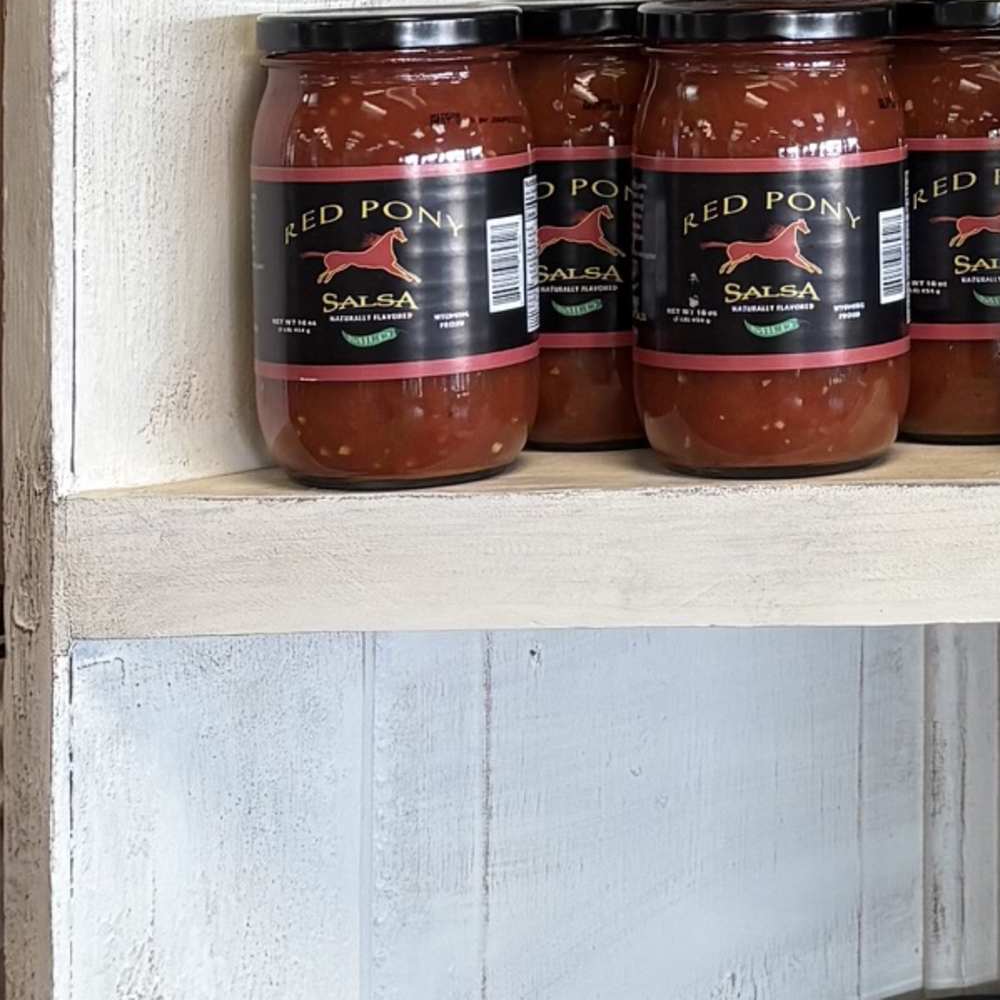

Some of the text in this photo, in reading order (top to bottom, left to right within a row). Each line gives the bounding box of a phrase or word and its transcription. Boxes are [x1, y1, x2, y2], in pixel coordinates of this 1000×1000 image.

[913, 171, 977, 210] RED
[285, 200, 464, 245] RED PONY
[683, 194, 748, 235] RED
[766, 191, 861, 229] PONY
[538, 265, 624, 283] SALSA
[322, 291, 419, 313] SALSA
[724, 282, 821, 303] SALSA
[329, 314, 371, 322] NATURALLY
[732, 305, 774, 313] NATURALLY
